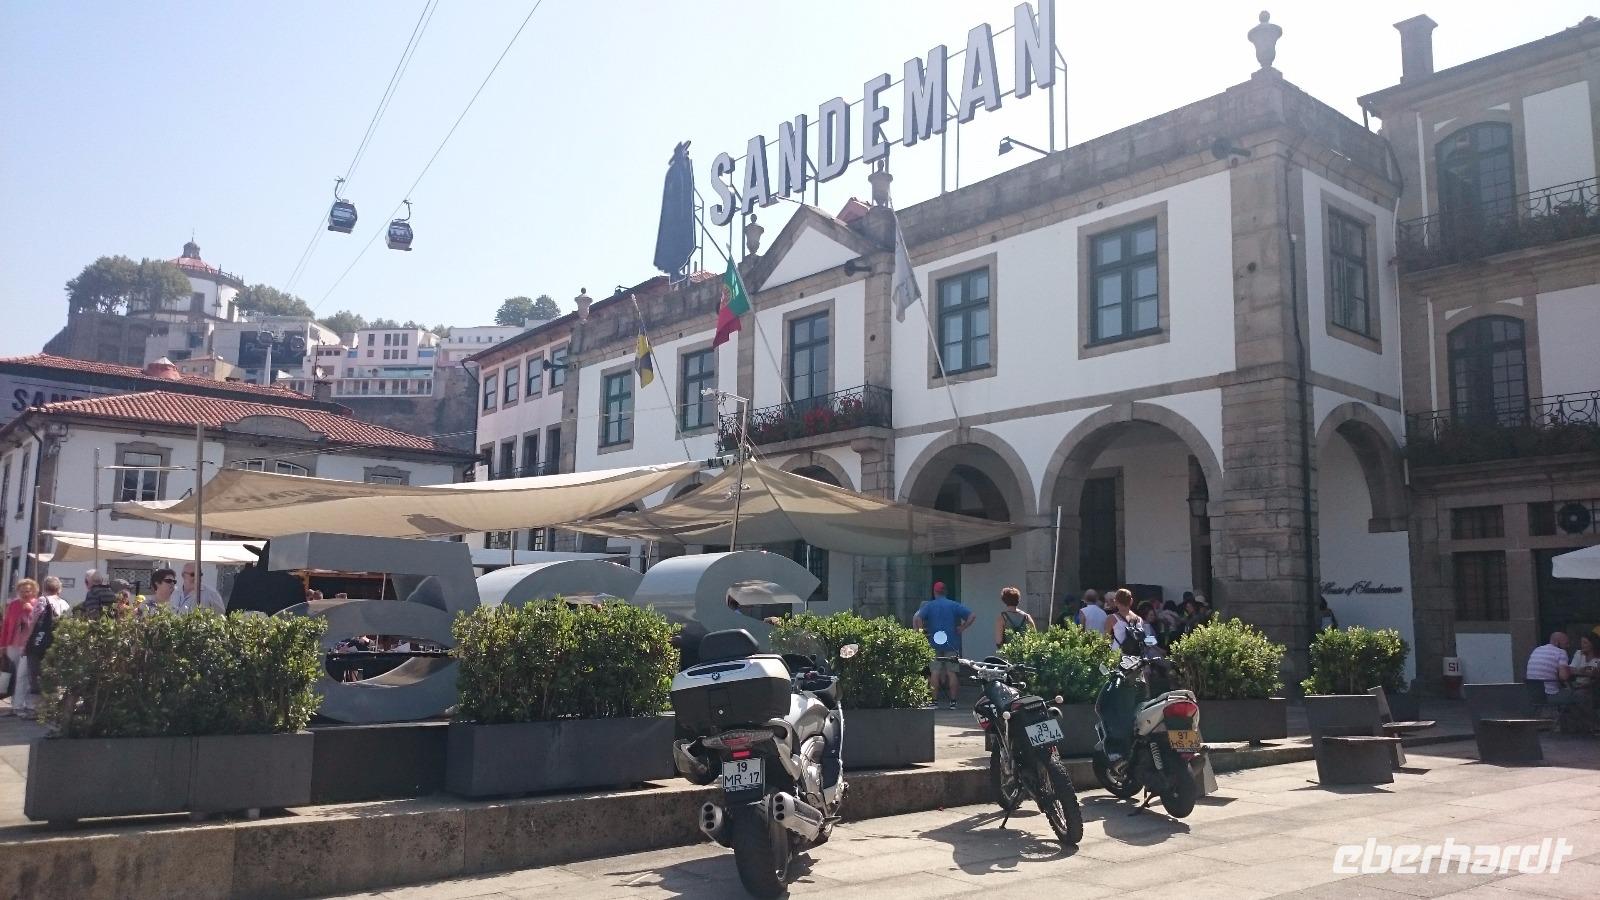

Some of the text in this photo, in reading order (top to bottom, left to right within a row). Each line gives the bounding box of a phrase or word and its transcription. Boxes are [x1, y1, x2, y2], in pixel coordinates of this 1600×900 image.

[710, 0, 1055, 226] SANDEMAN
[12, 389, 83, 411] SA
[1036, 723, 1049, 734] 39
[737, 762, 748, 773] 19
